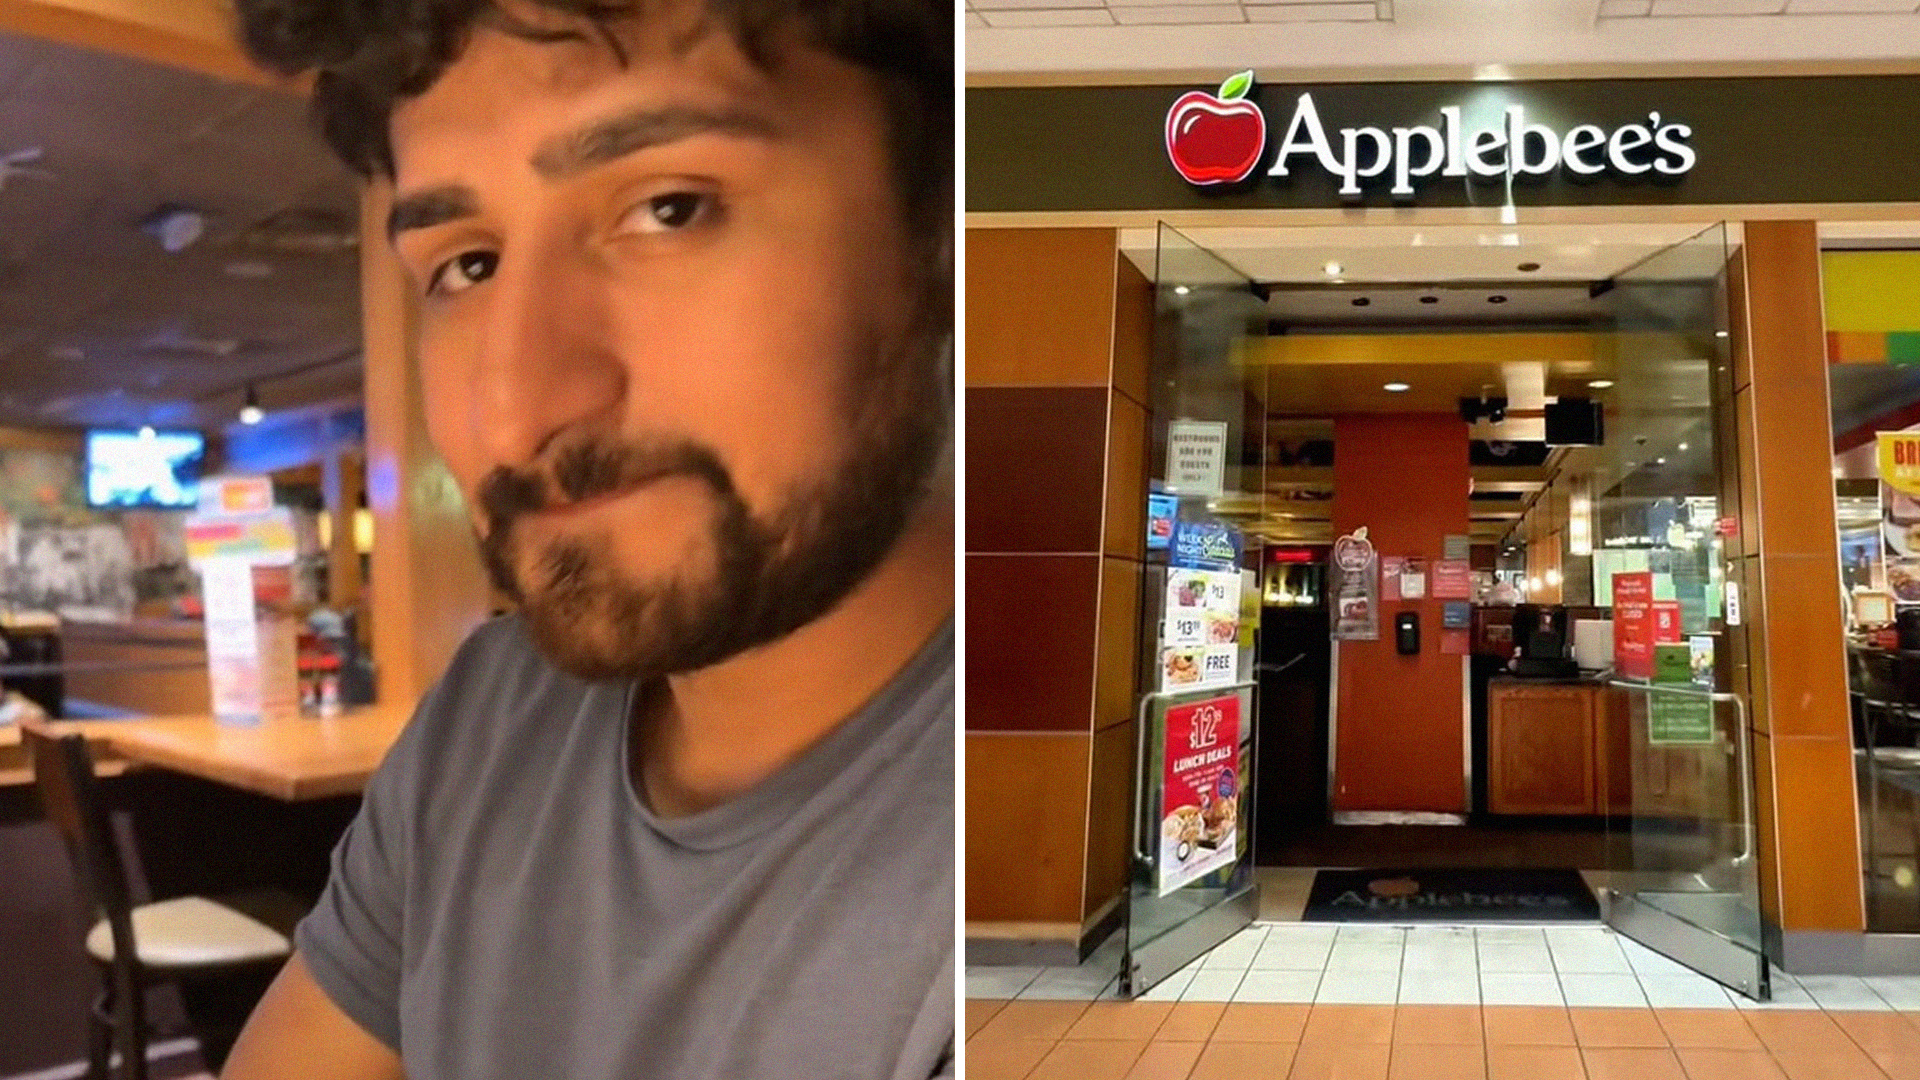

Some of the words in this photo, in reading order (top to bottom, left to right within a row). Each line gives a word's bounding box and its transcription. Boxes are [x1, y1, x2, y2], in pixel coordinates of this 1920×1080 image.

[1267, 92, 1696, 194] Applebee's
[1206, 654, 1231, 670] FREE
[1173, 753, 1206, 774] LUNCH
[1207, 745, 1232, 765] DEALS
